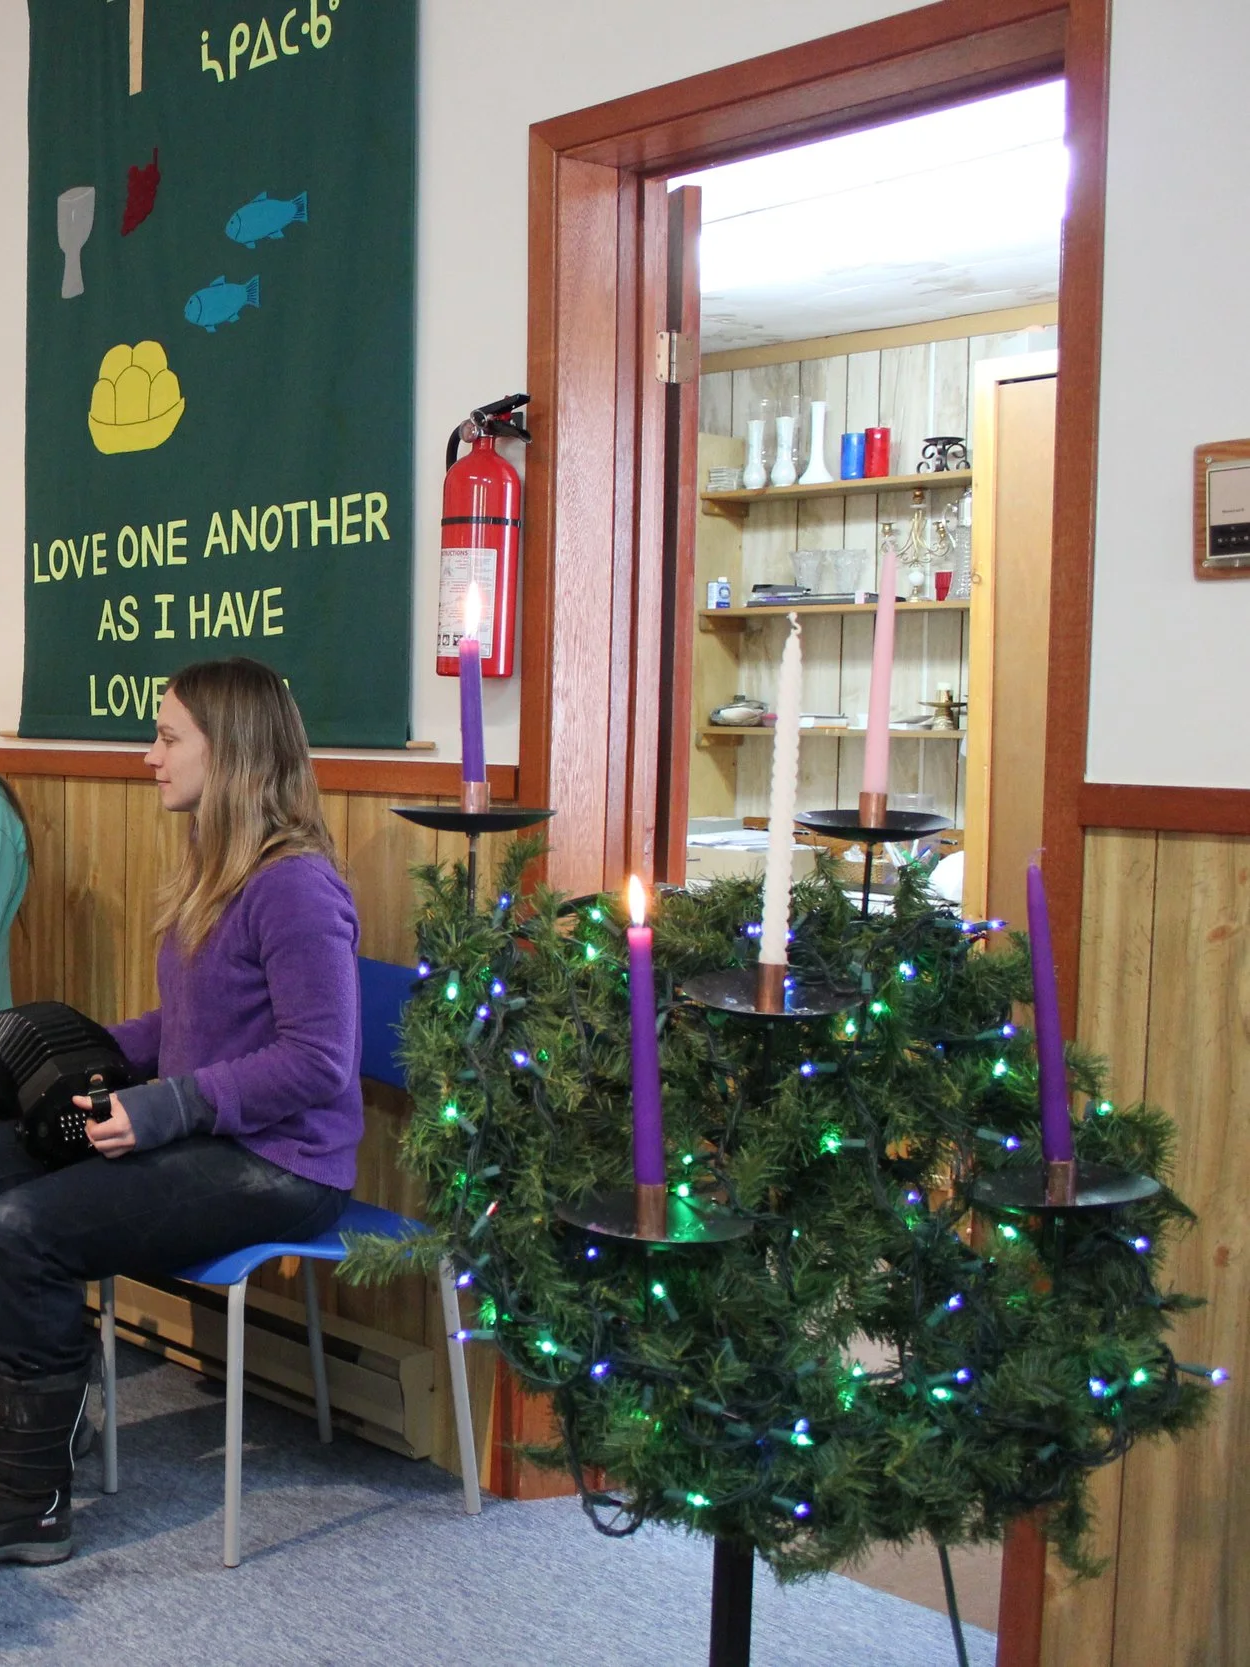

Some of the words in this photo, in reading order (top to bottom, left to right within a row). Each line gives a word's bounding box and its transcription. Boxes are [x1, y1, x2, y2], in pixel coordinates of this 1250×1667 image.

[33, 532, 108, 584] LOVE
[117, 519, 188, 568] ONE
[203, 491, 391, 558] ANOTHER
[97, 595, 140, 641] AS
[154, 593, 175, 639] I
[189, 587, 284, 640] HAVE
